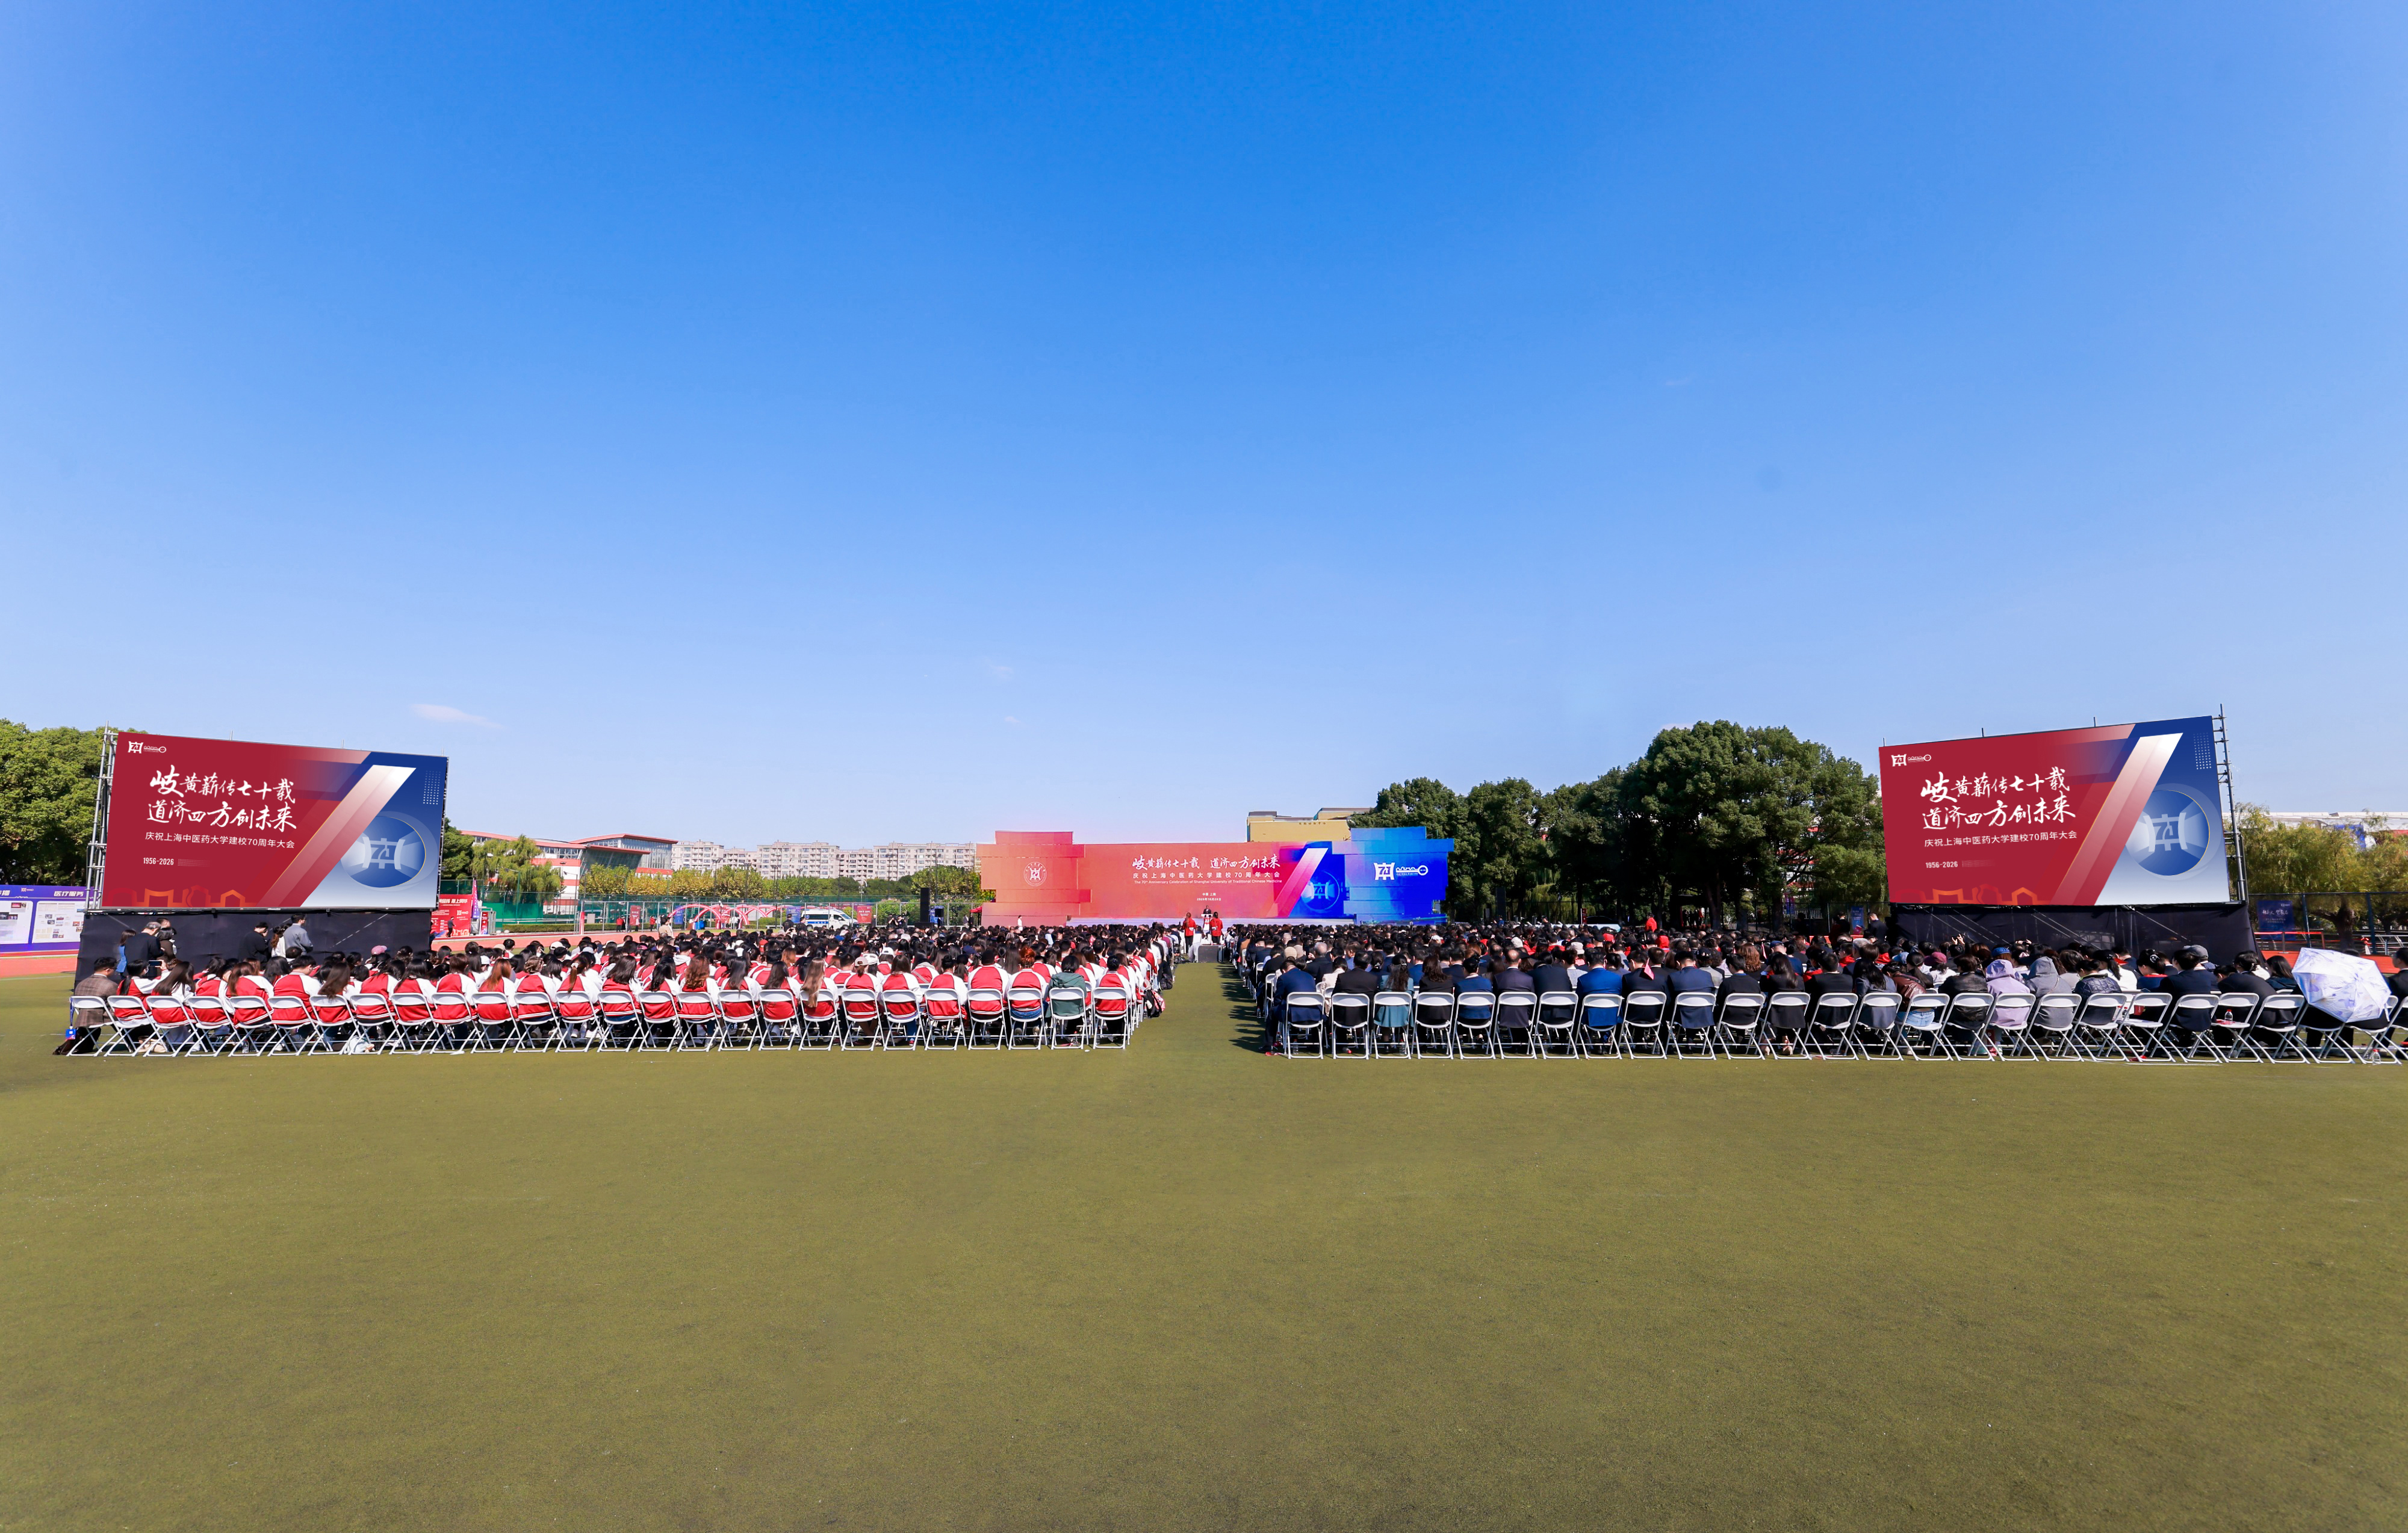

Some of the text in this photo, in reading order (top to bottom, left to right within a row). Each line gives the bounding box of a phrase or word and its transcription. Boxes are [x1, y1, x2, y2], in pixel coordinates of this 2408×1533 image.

[150, 764, 296, 804] 岐黄薪传七十载
[1920, 766, 2070, 803] 岐黄薪传七十载
[147, 799, 297, 832] 道济四方创未来
[1922, 790, 2076, 829] 道济四方创未来
[145, 832, 295, 849] 庆祝上海中医药大学建校70周年大会
[1925, 831, 2077, 847] 庆祝上海中医药大学建校70周年大会
[143, 857, 174, 866] 1956-2026
[1210, 853, 1280, 869] 道济四方创未来
